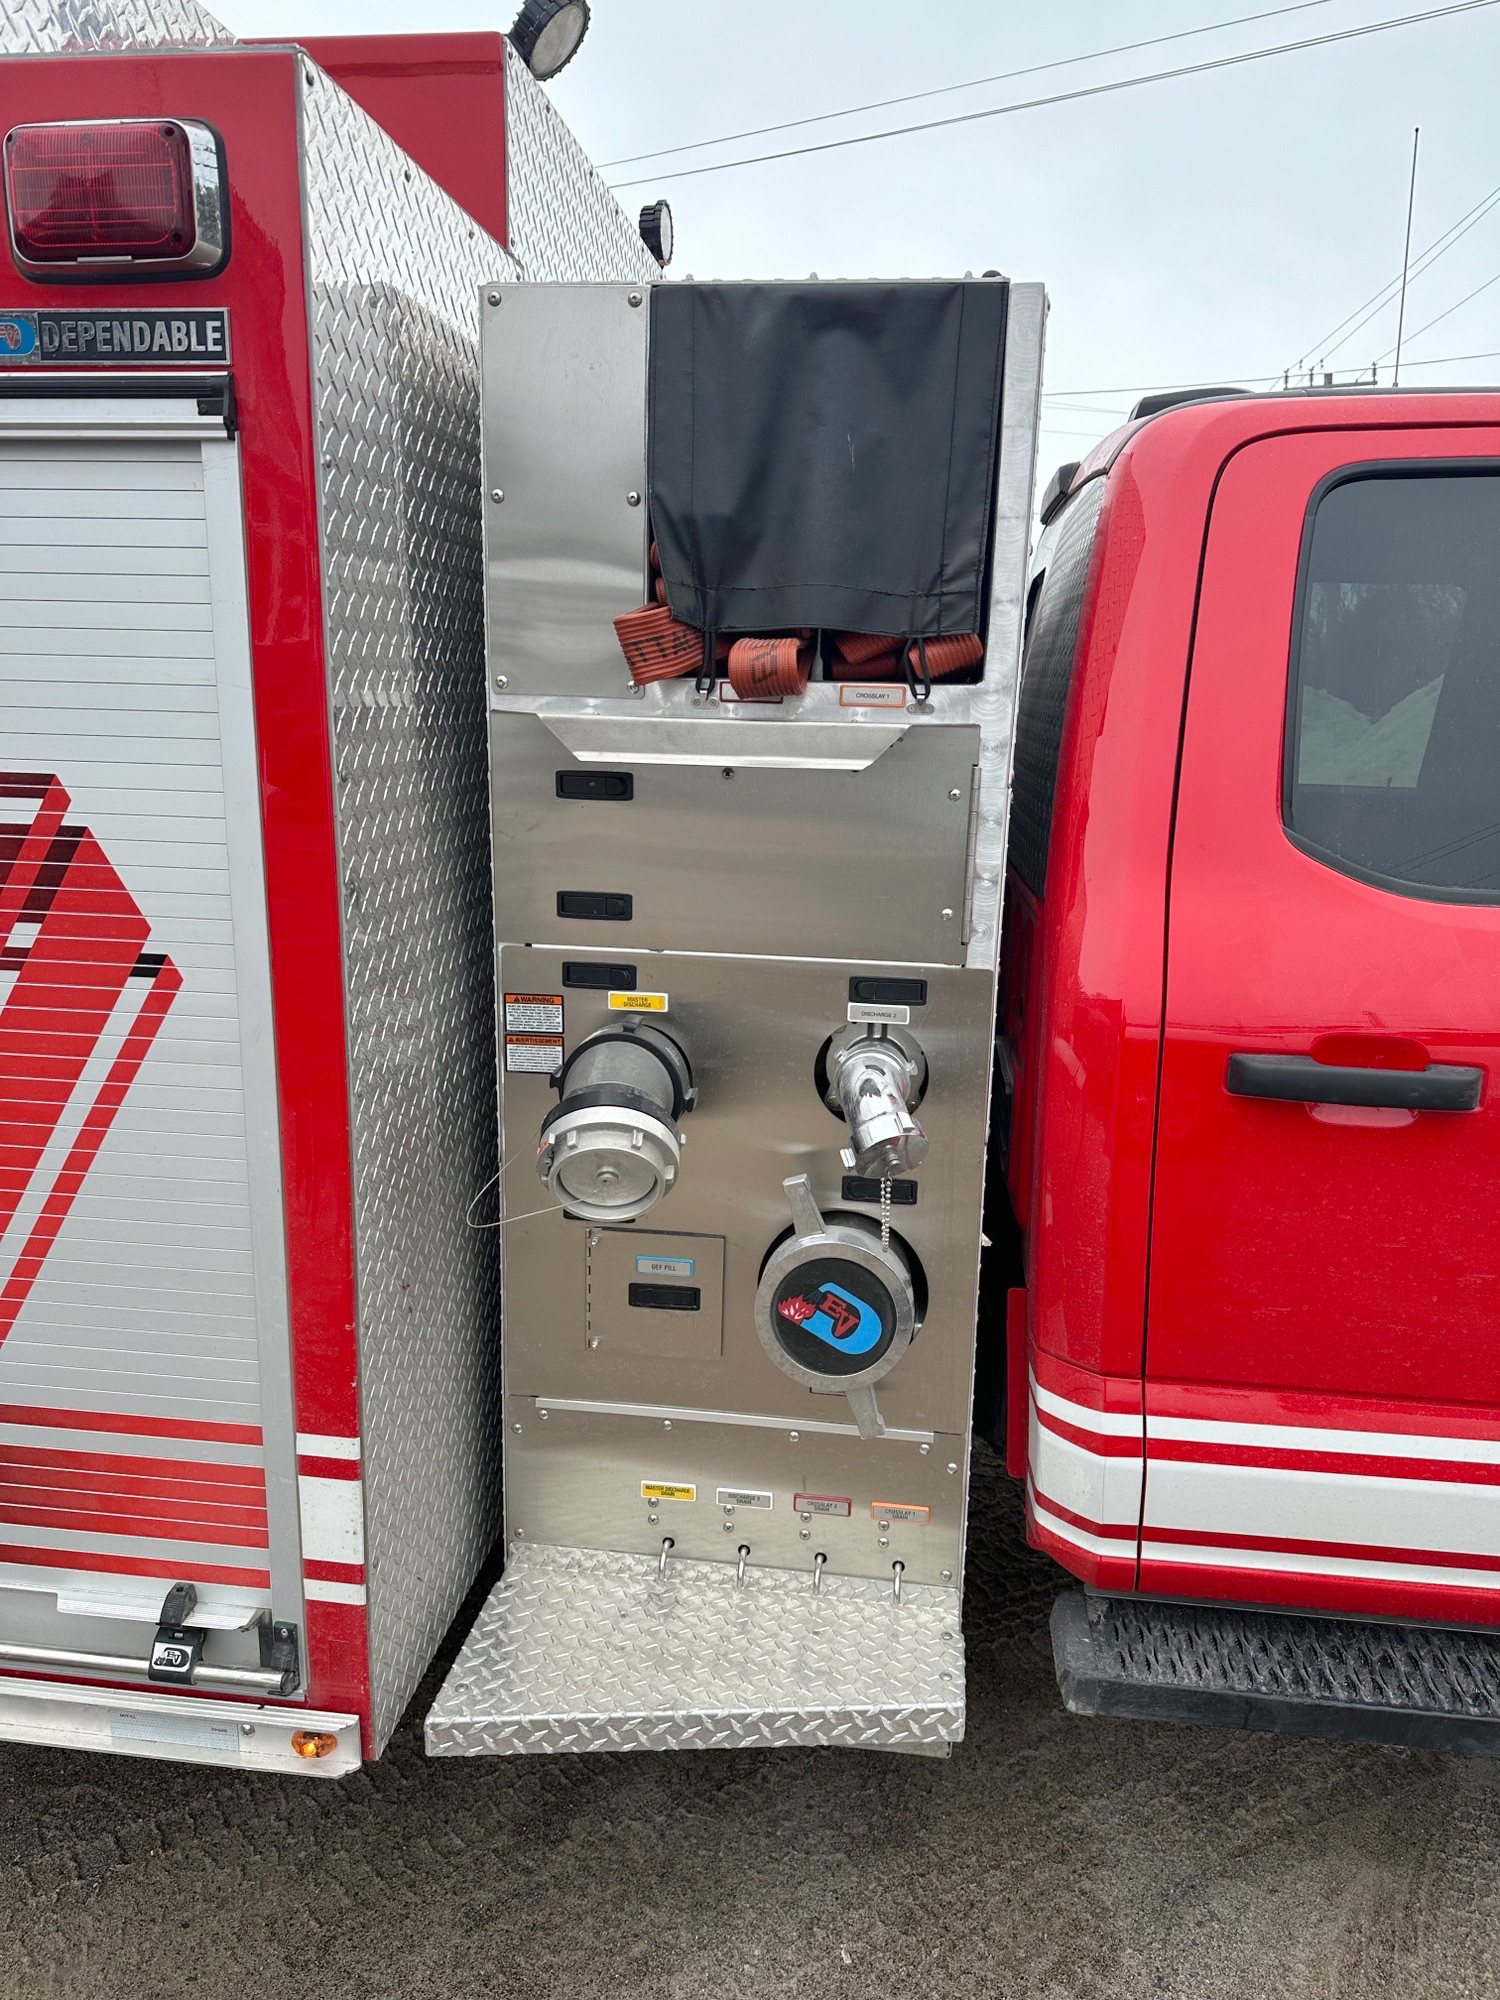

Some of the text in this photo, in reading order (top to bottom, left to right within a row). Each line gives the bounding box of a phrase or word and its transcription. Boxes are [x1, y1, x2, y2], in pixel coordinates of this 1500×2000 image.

[41, 320, 223, 352] DEPENDABLE
[521, 996, 555, 1004] WARNING
[807, 1500, 833, 1508] CROSSLAY
